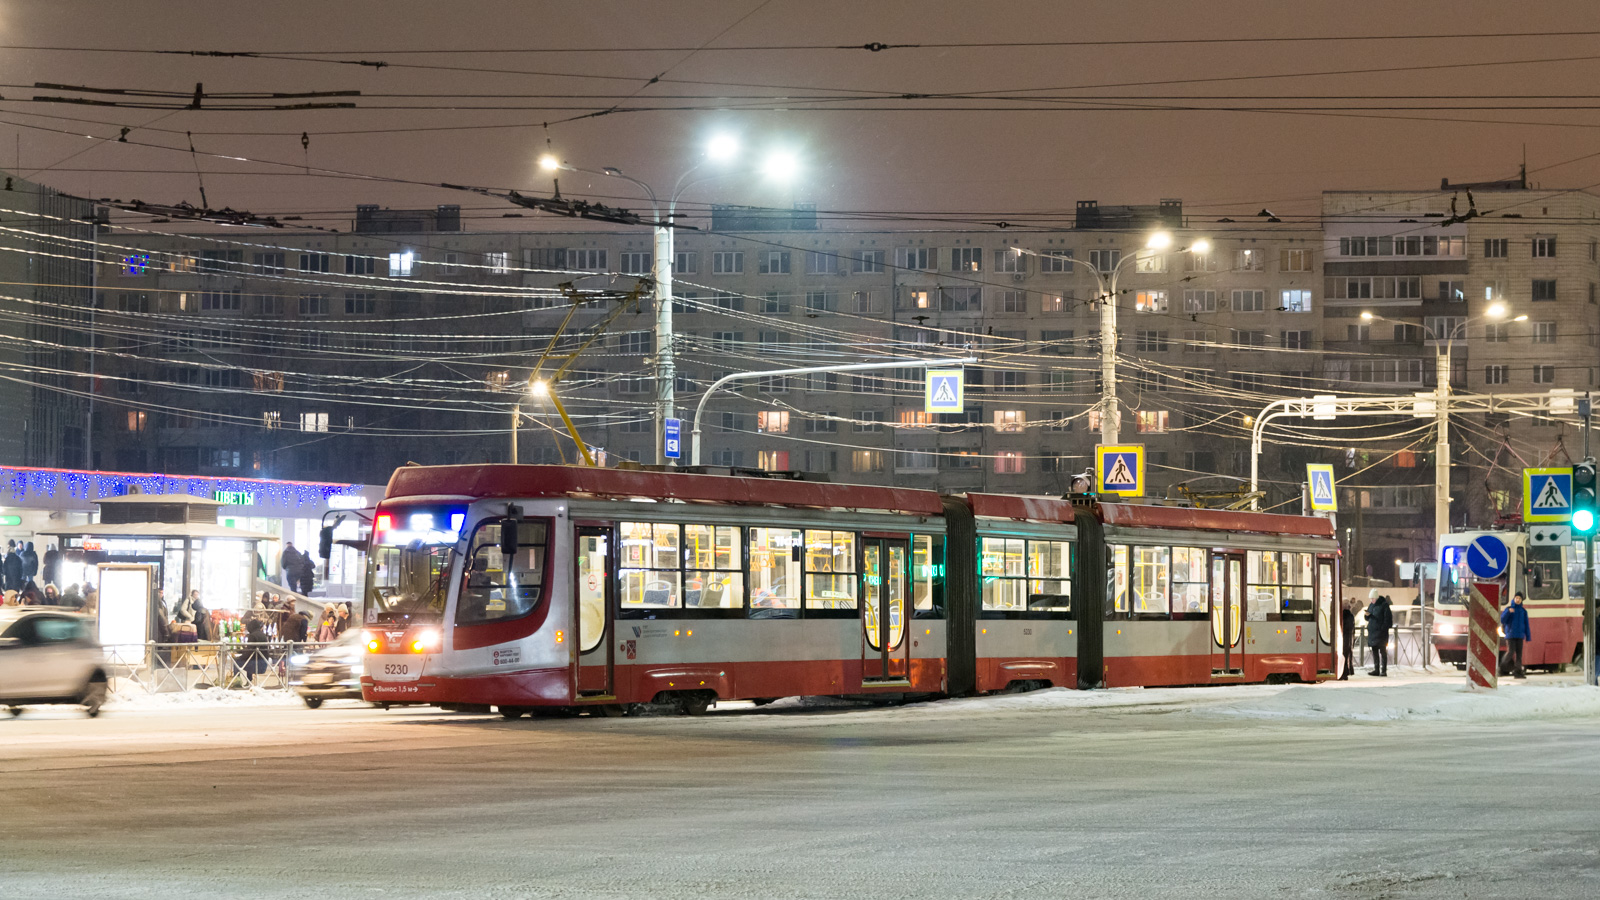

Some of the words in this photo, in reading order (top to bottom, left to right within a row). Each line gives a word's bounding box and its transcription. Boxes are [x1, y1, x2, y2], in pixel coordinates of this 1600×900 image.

[215, 490, 254, 505] ЦВЕТЫ
[384, 663, 409, 675] 5230
[398, 685, 407, 693] 1,5
